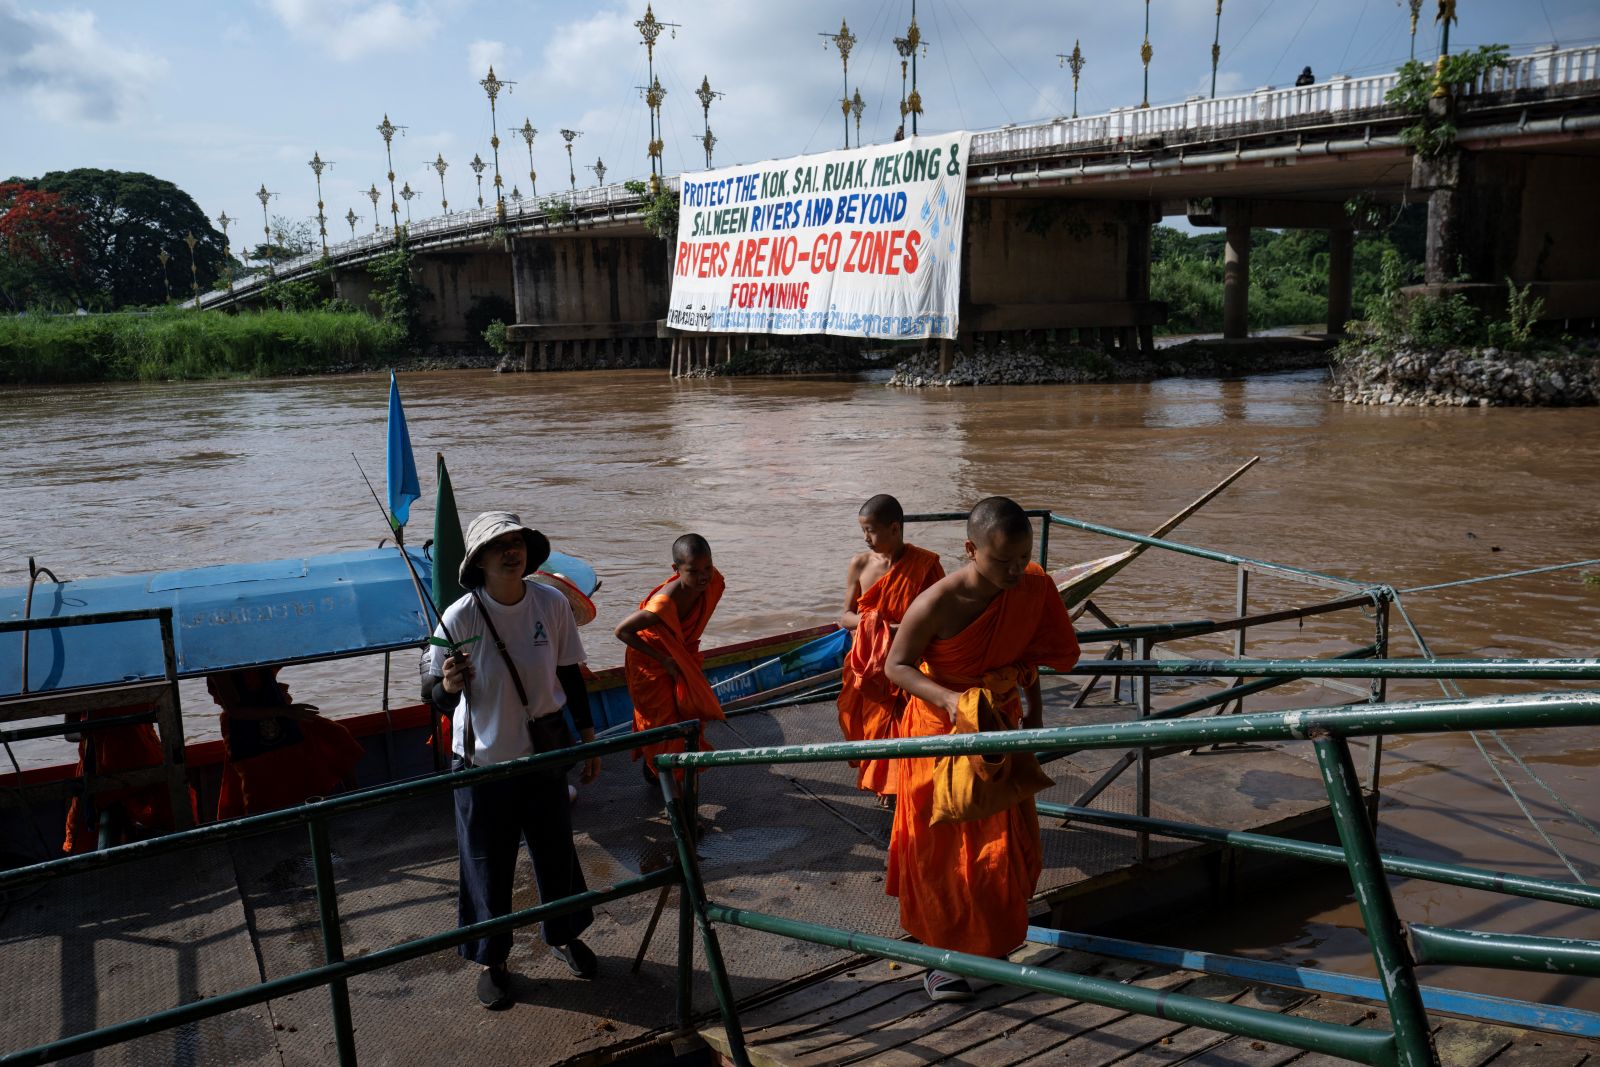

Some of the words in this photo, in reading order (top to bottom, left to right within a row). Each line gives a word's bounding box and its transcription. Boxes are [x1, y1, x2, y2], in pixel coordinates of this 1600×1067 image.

[683, 178, 734, 208] PROTECT
[735, 172, 761, 204] THE
[870, 147, 942, 188] MEKONG
[946, 142, 960, 177] &
[691, 206, 750, 237] SALWEEN
[750, 199, 803, 233] RIVERS
[803, 197, 834, 228] AND
[834, 191, 908, 225] BEYOND
[676, 241, 730, 279] RIVERS
[731, 237, 770, 278] ARE
[842, 229, 922, 276] ZONES
[729, 282, 759, 309] FOR
[757, 281, 810, 310] MINING
